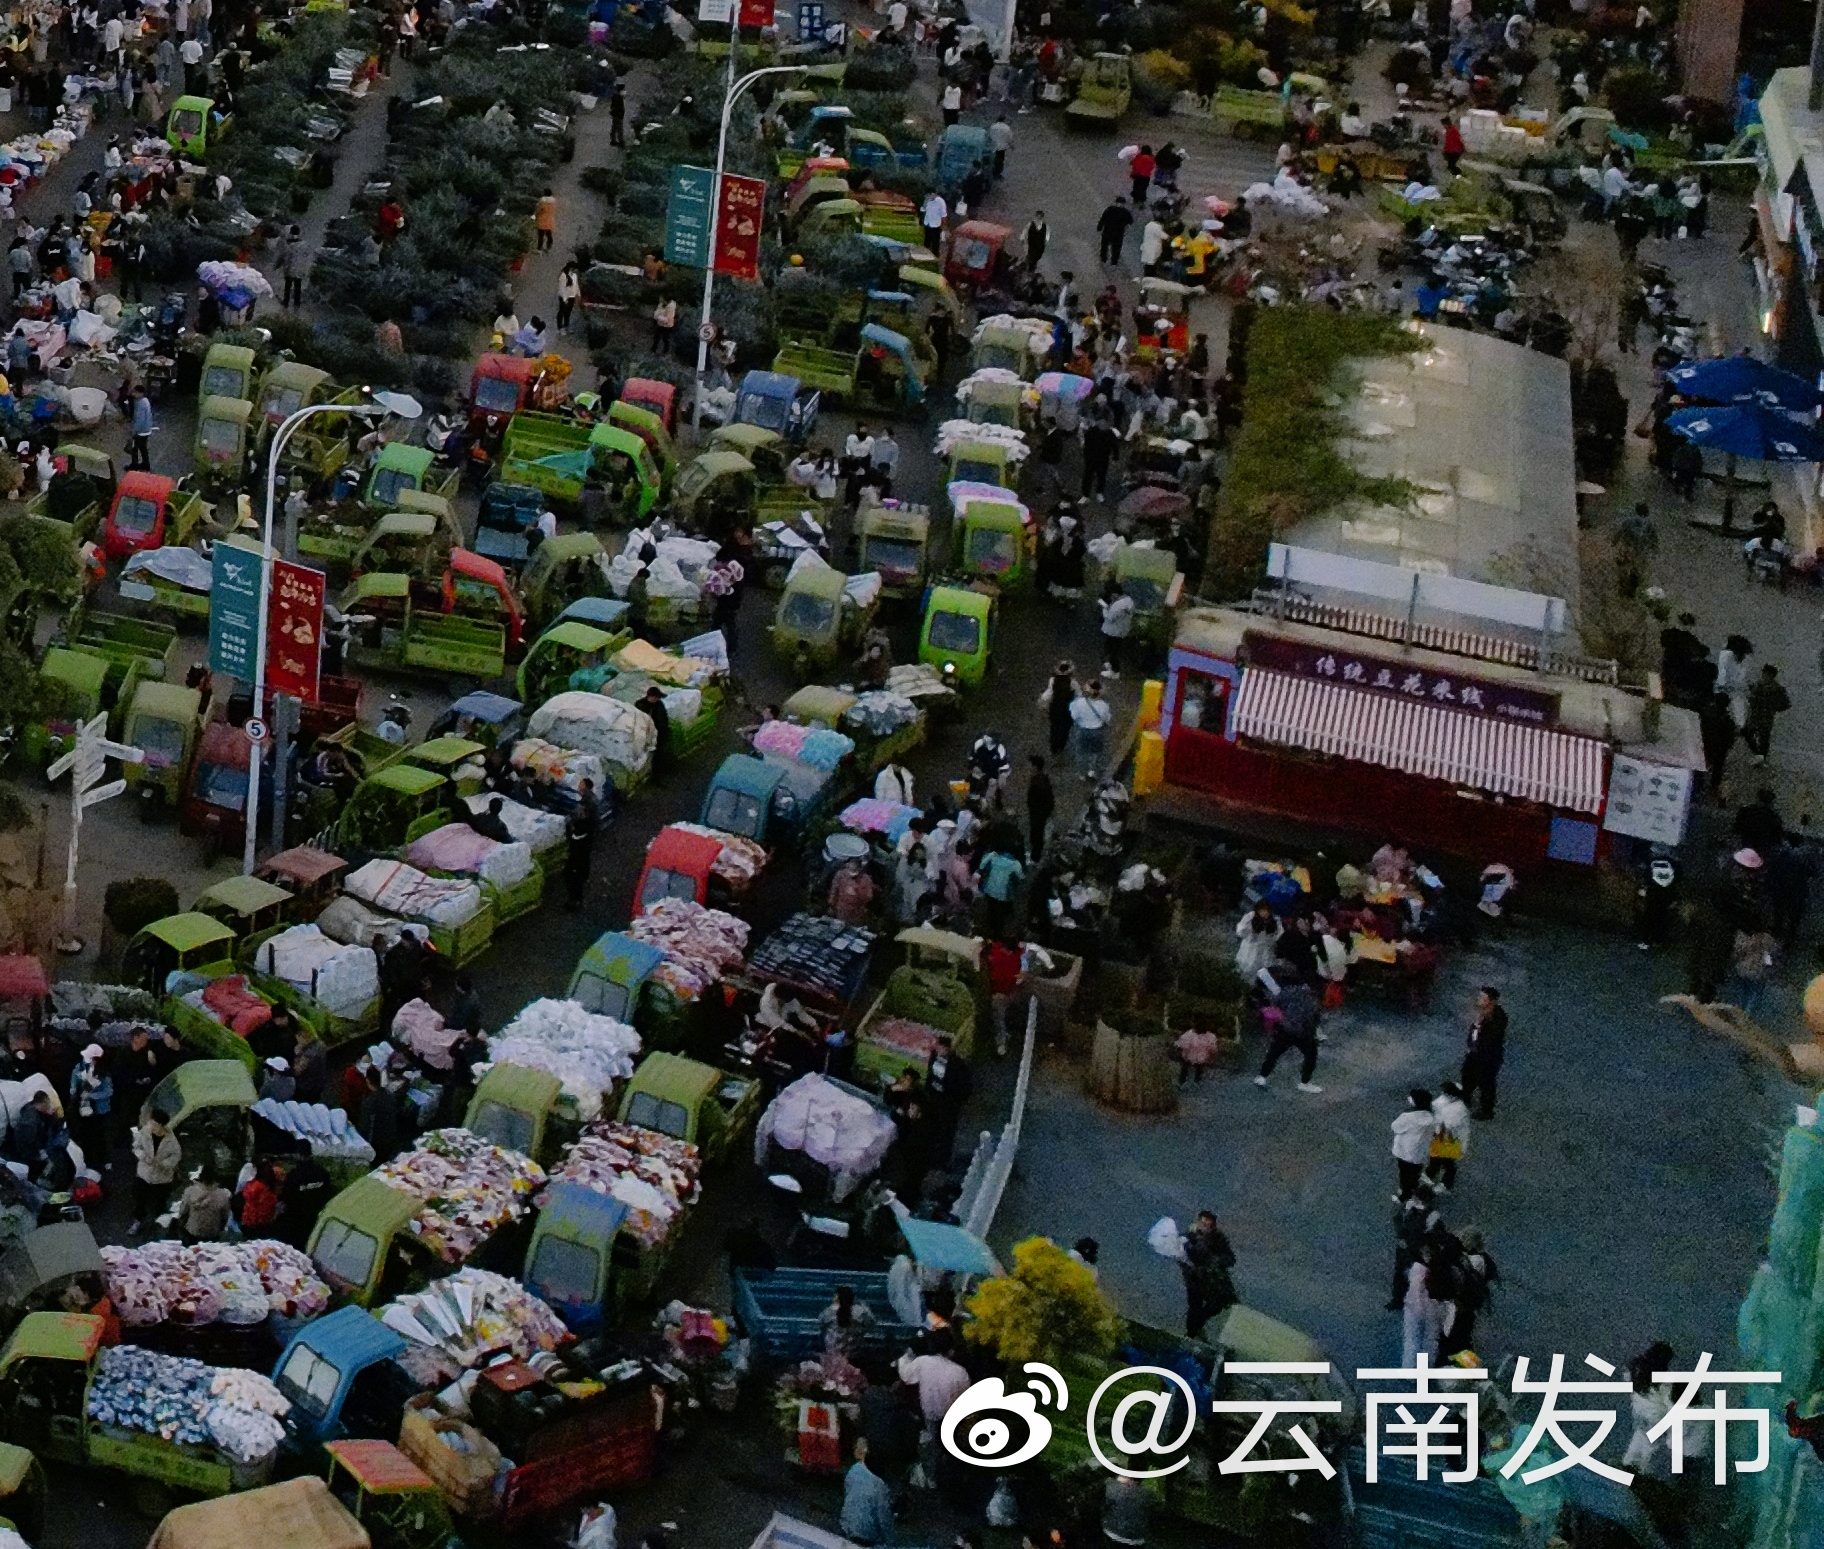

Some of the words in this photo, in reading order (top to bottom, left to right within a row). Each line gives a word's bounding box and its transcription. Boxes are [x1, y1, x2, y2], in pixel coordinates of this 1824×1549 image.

[1315, 654, 1485, 710] 传统豆花米线
[251, 722, 261, 737] 5
